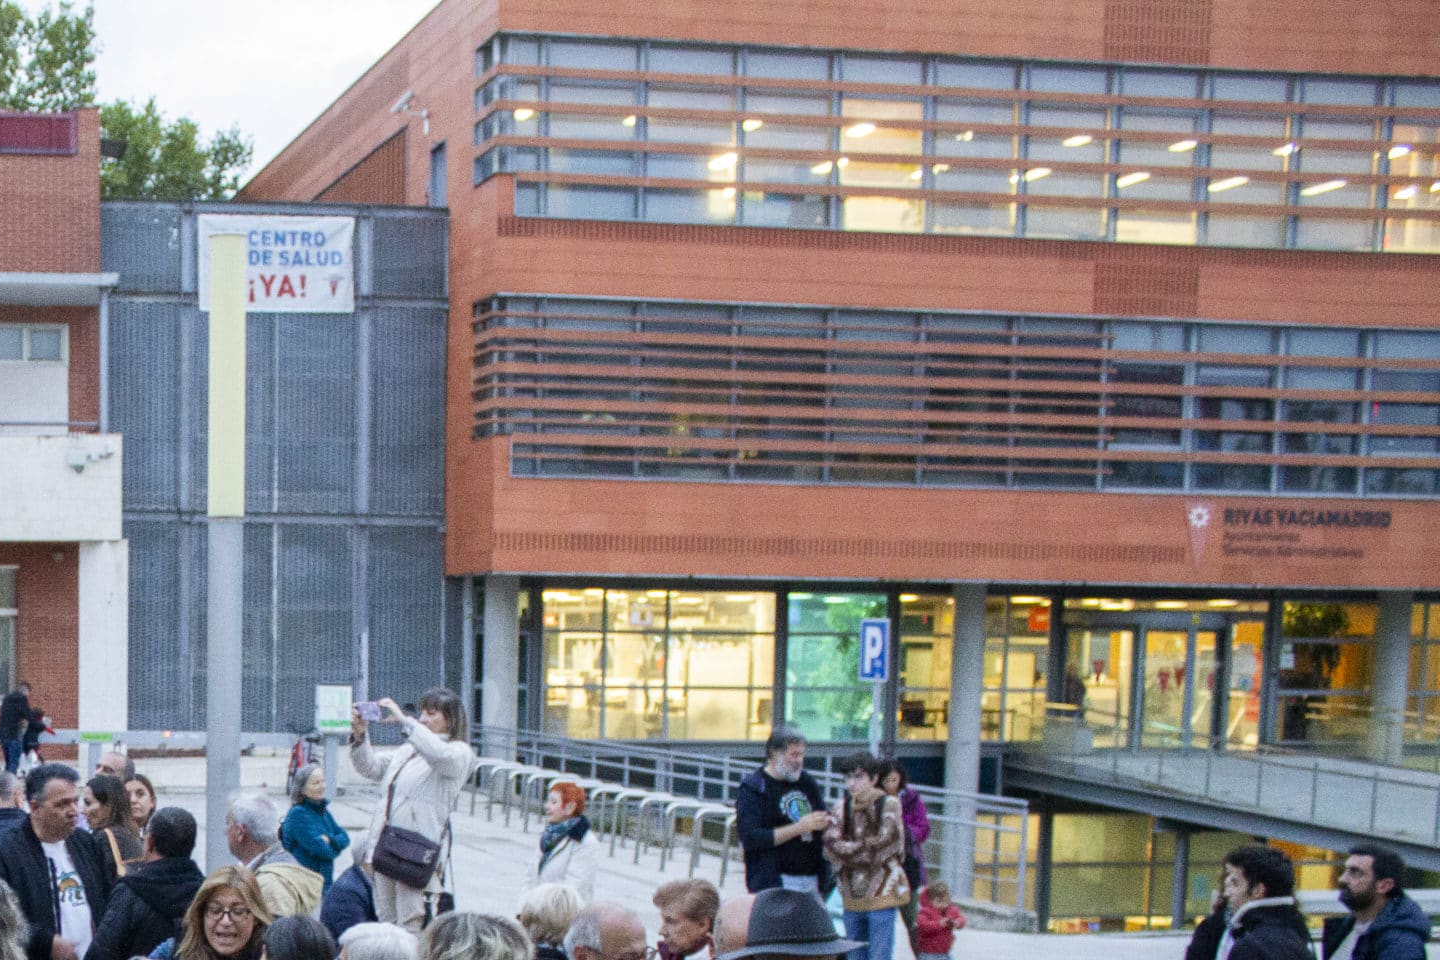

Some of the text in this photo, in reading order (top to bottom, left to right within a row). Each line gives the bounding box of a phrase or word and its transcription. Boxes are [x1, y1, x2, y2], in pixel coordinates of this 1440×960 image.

[248, 230, 327, 247] CENTRO
[248, 250, 342, 266] DE SALUD
[248, 274, 307, 303] ¡YA!
[1224, 508, 1392, 528] RIVAS VACIAMADRID
[864, 626, 883, 674] P
